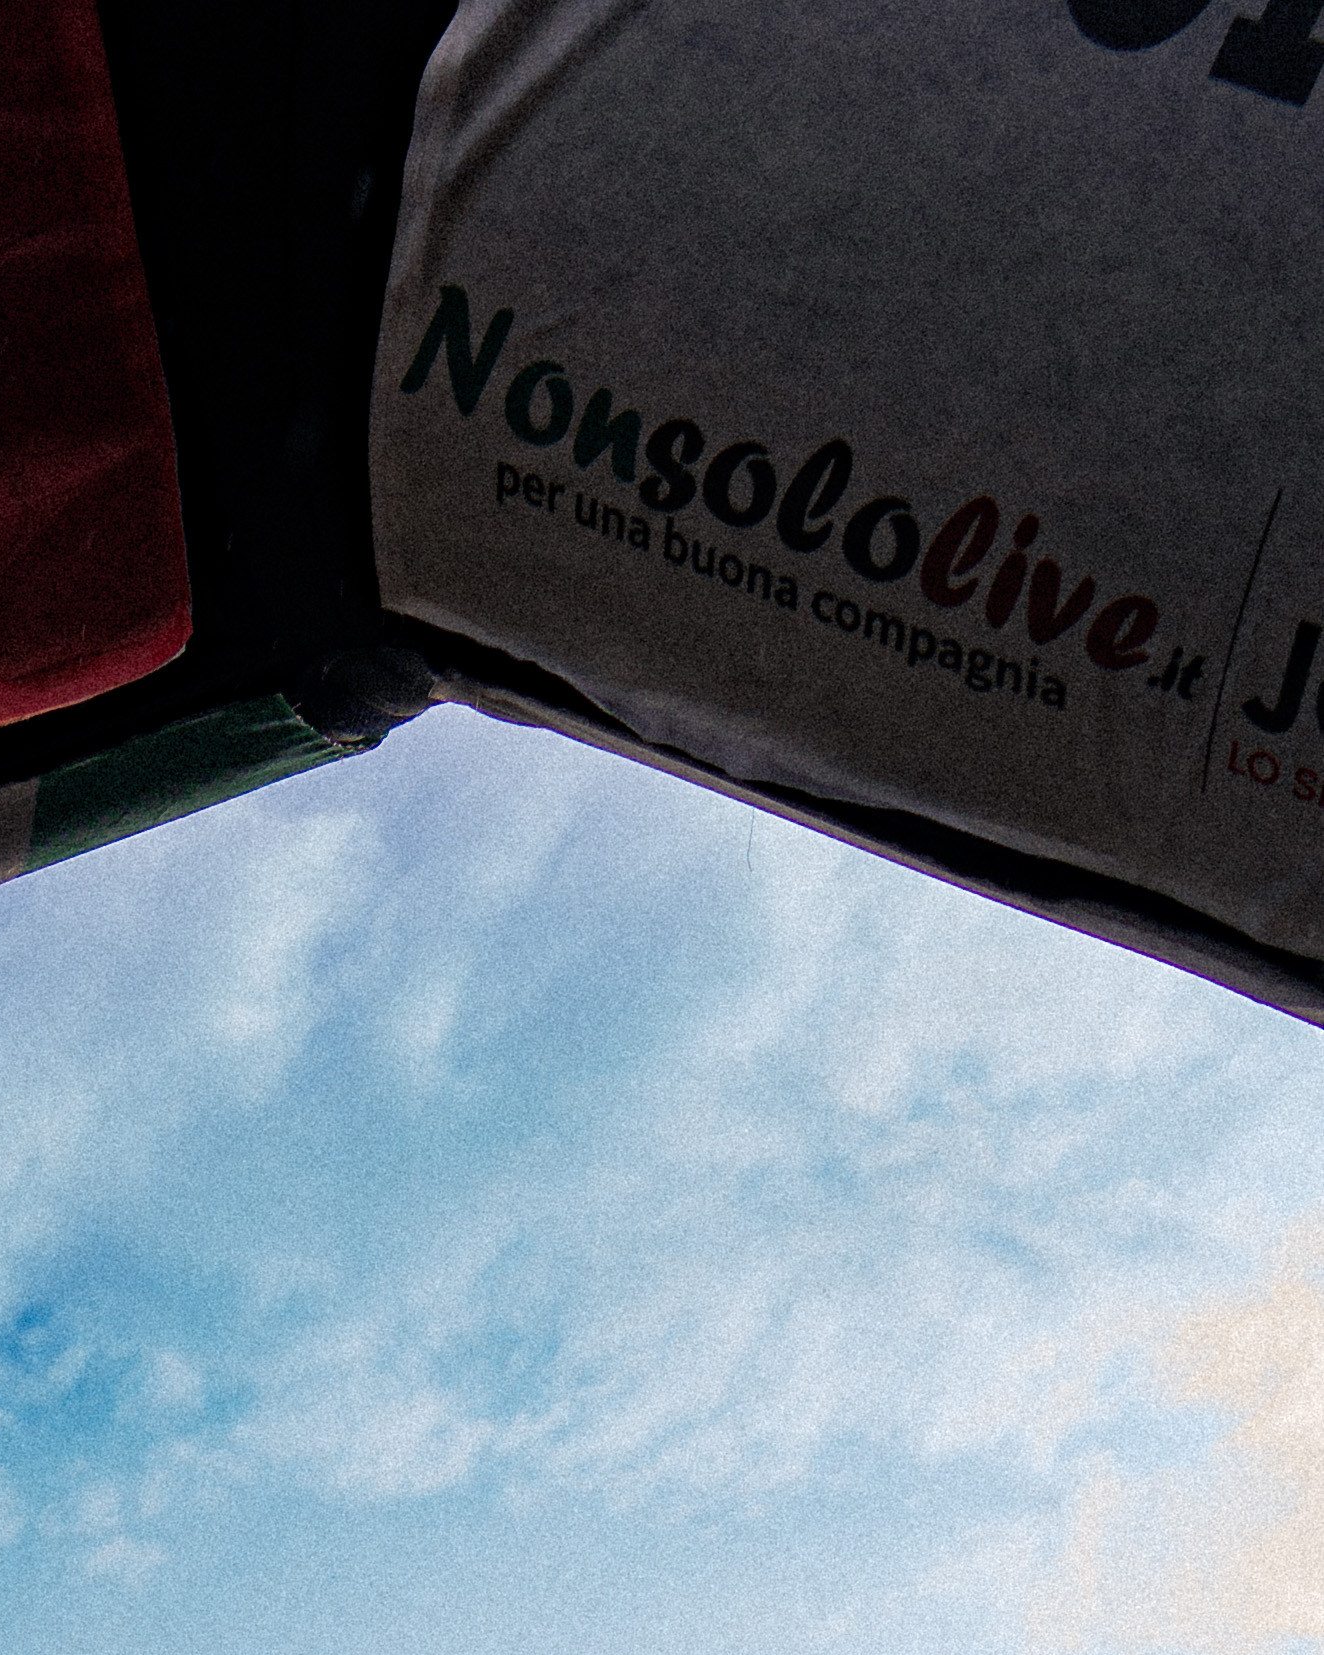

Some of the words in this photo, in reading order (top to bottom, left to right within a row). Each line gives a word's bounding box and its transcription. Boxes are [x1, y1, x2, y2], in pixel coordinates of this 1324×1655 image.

[496, 461, 566, 512] per
[575, 488, 651, 553] una
[661, 515, 799, 609] buona
[810, 587, 1069, 711] compagnia
[1227, 739, 1281, 787] LO
